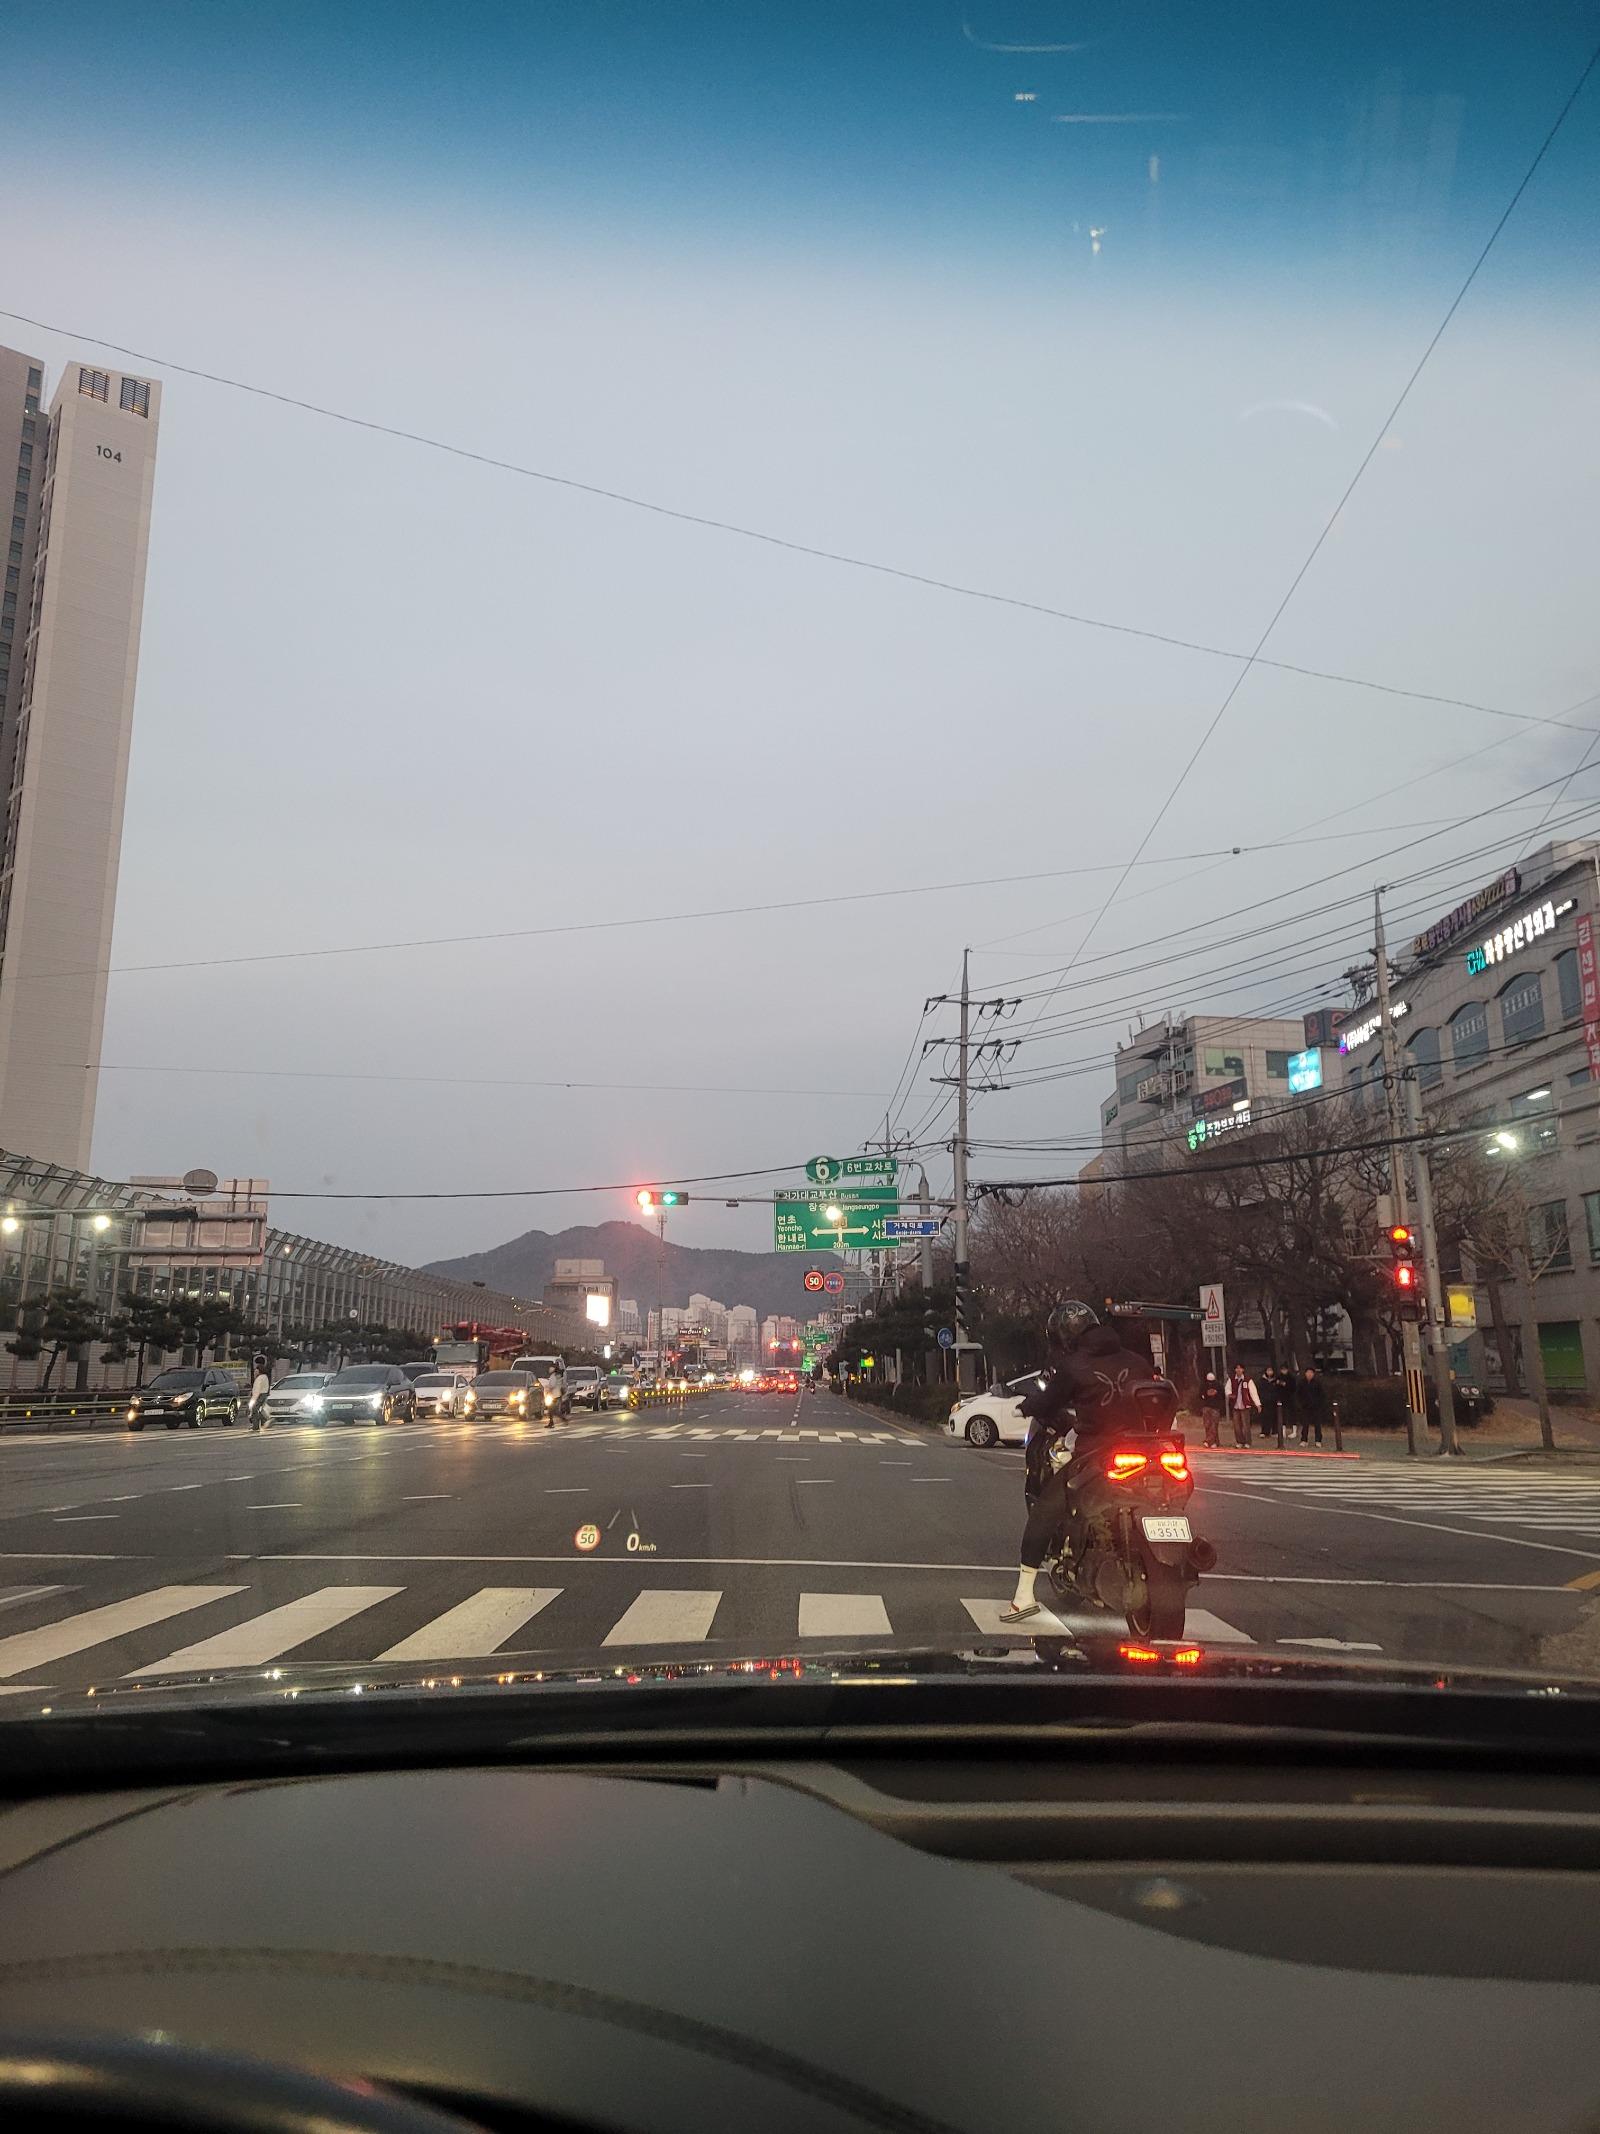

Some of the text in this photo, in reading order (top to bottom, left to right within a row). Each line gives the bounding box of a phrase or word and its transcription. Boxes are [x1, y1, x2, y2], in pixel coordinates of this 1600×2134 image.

[96, 445, 122, 463] 104
[815, 1157, 830, 1180] 6
[847, 1162, 893, 1173] 6번 교차로
[777, 1215, 797, 1225] 연초
[777, 1232, 806, 1244] 한내리
[810, 1277, 820, 1286] 50
[1158, 1528, 1186, 1538] 3511
[580, 1533, 657, 1552] 50 0 km/h
